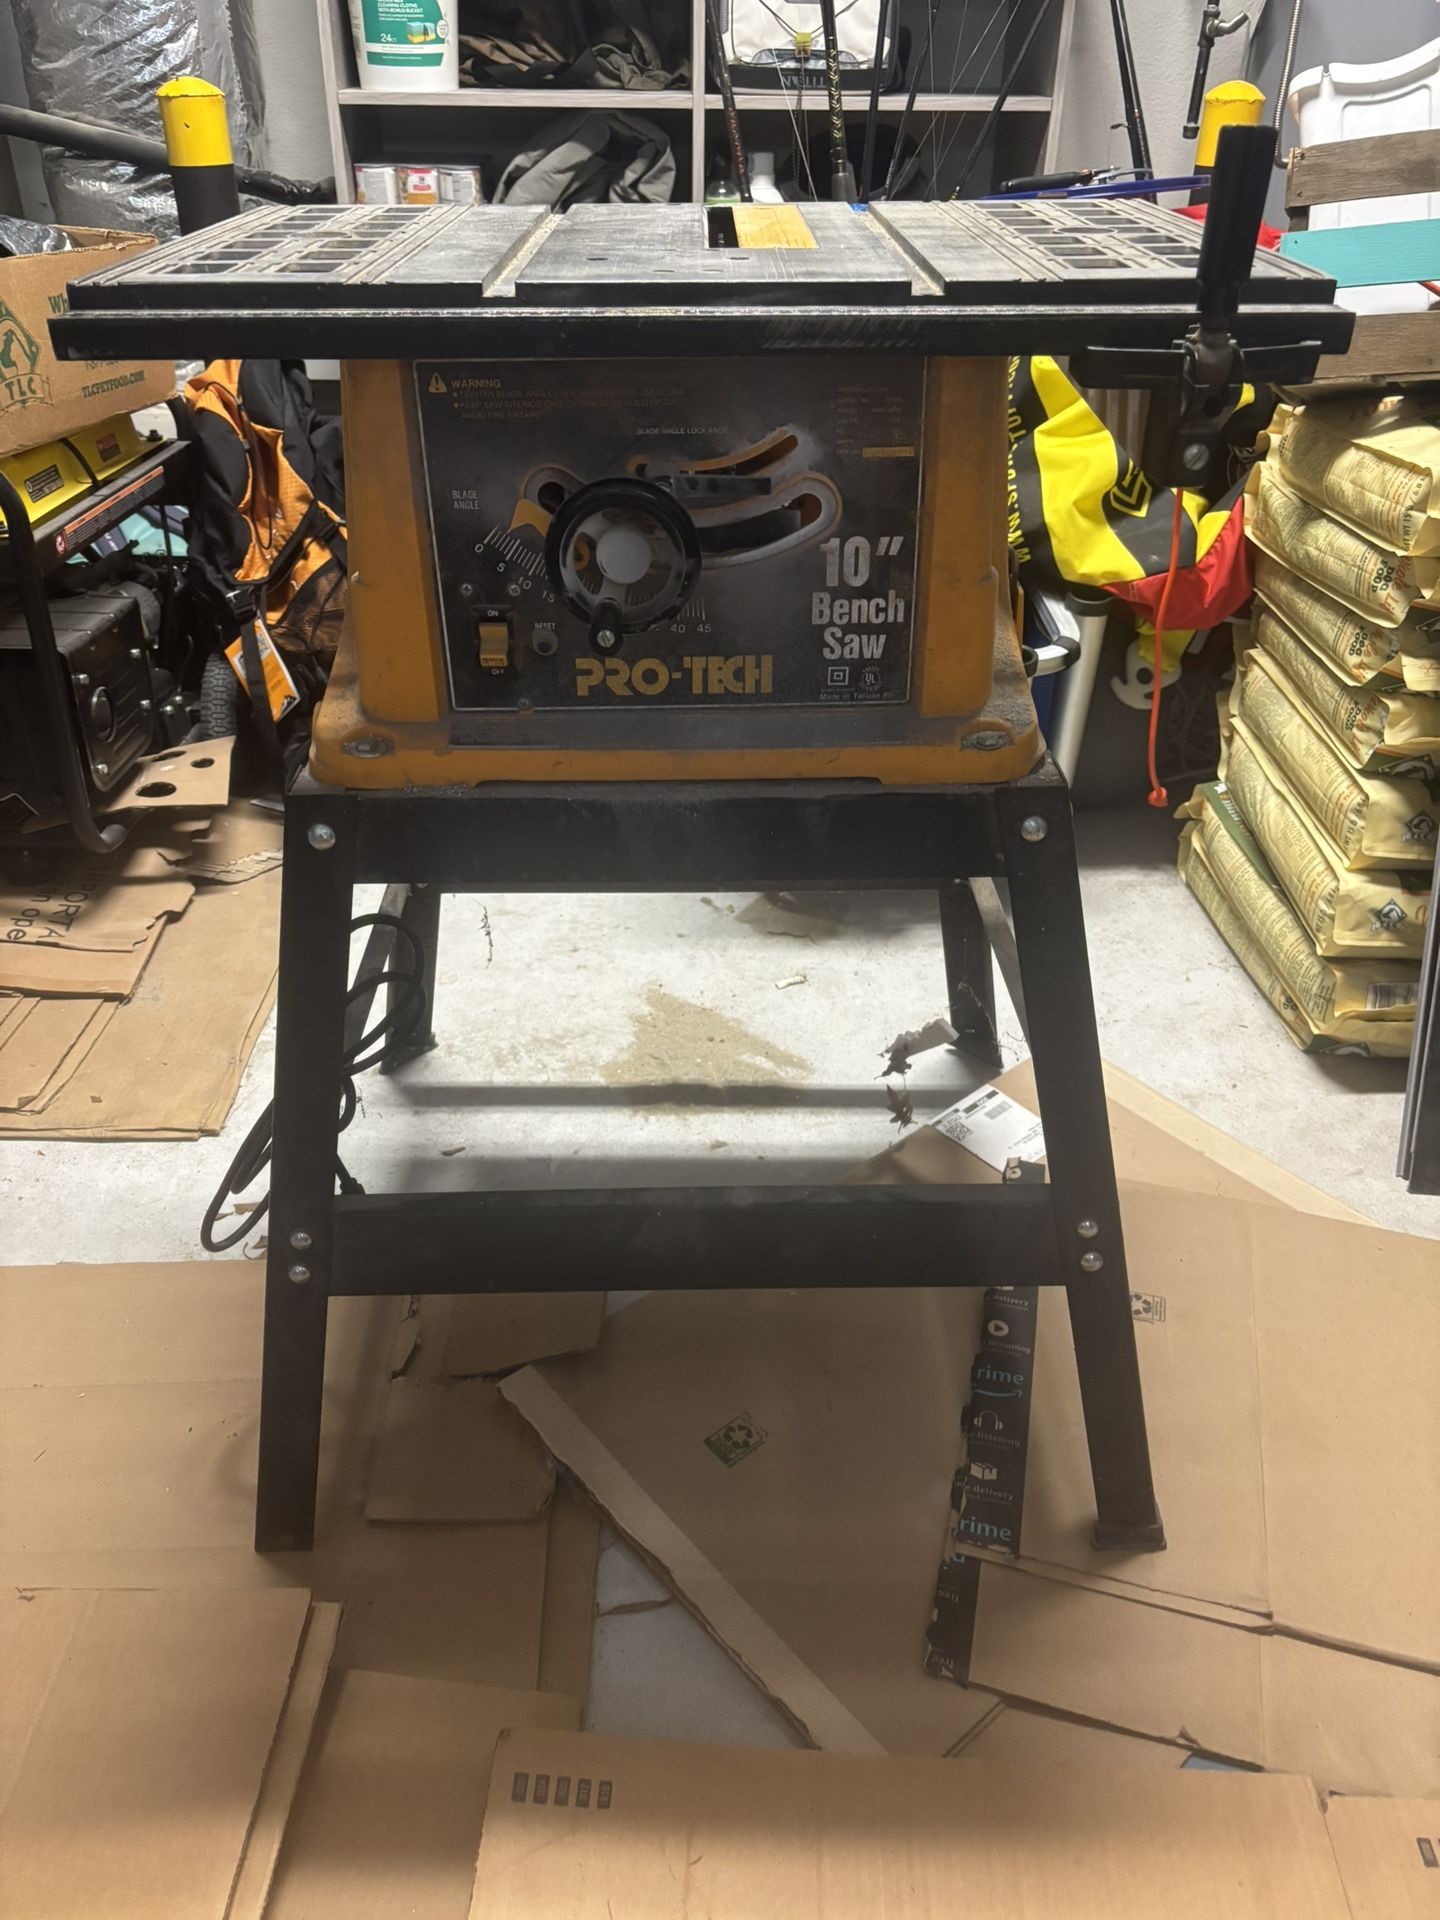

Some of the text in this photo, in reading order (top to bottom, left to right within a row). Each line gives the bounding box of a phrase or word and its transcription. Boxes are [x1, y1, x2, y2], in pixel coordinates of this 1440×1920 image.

[48, 293, 71, 314] Wh
[5, 377, 37, 401] TLC
[81, 370, 145, 398] TLCPETFOOD.COM
[451, 379, 501, 389] WARNING
[452, 490, 479, 499] BLADE
[453, 501, 480, 510] ANGLE
[474, 543, 484, 553] 0
[496, 562, 506, 572] 5
[1371, 559, 1388, 593] FOOD
[517, 576, 532, 590] 10
[1378, 566, 1395, 592] DOG
[542, 590, 556, 603] 15
[811, 589, 905, 625] Bench
[534, 622, 556, 630] RESET
[670, 623, 686, 633] 40
[696, 623, 712, 633] 45
[823, 626, 887, 660] Saw
[574, 654, 774, 697] PRO-TECH
[37, 866, 110, 945] IMPORTA
[7, 908, 41, 941] ope
[992, 1294, 1029, 1307] delivery
[976, 1364, 1025, 1386] rime
[976, 1430, 1021, 1448] listening
[973, 1483, 1014, 1502] delivery
[959, 1515, 1013, 1542] rime
